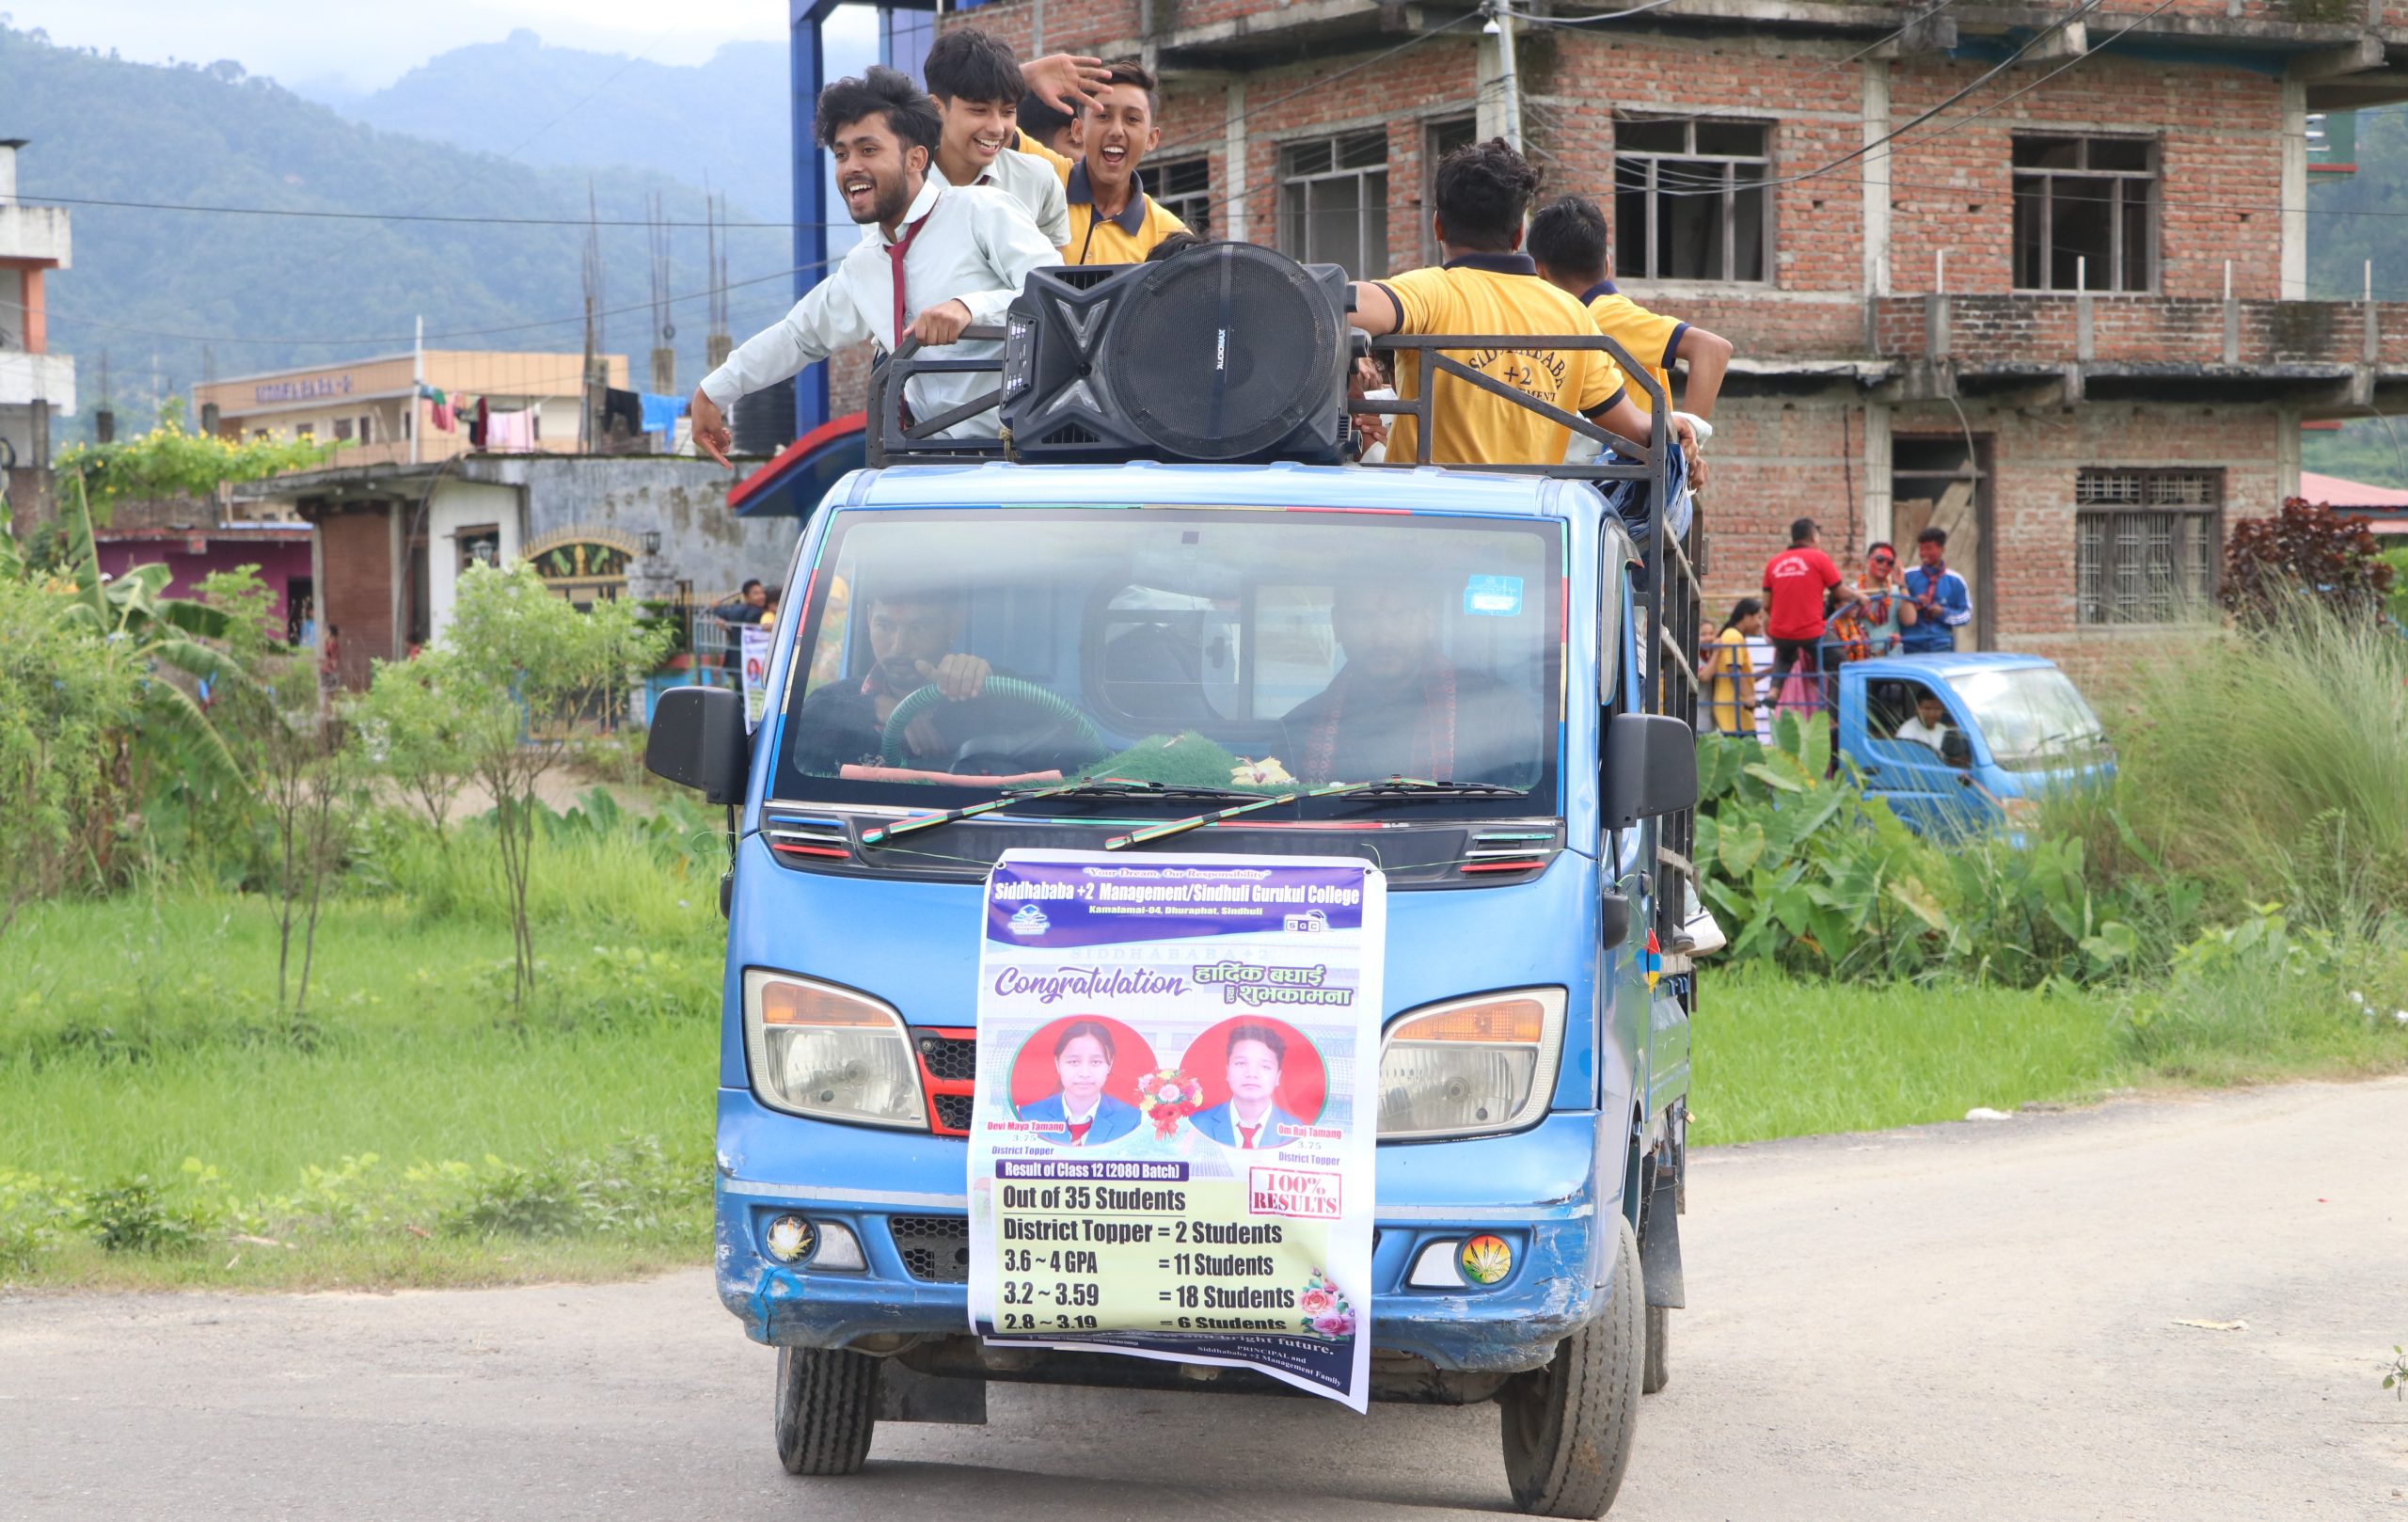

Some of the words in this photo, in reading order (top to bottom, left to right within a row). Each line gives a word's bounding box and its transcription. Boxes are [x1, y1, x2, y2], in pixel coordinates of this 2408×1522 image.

[1216, 328, 1226, 370] AUDIOMAX
[1503, 366, 1531, 386] +2
[1164, 869, 1184, 878] Our
[995, 881, 1074, 900] Siddhababa
[1077, 883, 1095, 900] +2
[1099, 882, 1250, 903] Management/Sindhuli
[1252, 885, 1305, 903] Gurukul
[1307, 885, 1360, 906] College
[1088, 905, 1164, 915] Kamalamai-04,
[1221, 907, 1263, 915] Sindhuli
[1194, 961, 1265, 983] हार्दिक
[994, 966, 1193, 1005] Congratulation
[1238, 985, 1354, 1007] शुभकामना
[988, 1121, 1006, 1131] Devi
[1007, 1122, 1030, 1133] Maya
[1031, 1122, 1065, 1133] Tamang
[1278, 1125, 1292, 1135] Om
[1308, 1127, 1342, 1140] Tamang
[991, 1146, 1023, 1155] District
[1024, 1147, 1054, 1156] Topper
[1278, 1151, 1309, 1164] District
[1310, 1154, 1340, 1166] Topper
[1005, 1162, 1042, 1177] Result
[1043, 1163, 1055, 1177] of
[1056, 1163, 1089, 1178] Class
[1091, 1163, 1104, 1178] 12
[1105, 1163, 1140, 1178] (2080
[1142, 1164, 1180, 1179] Batch)
[1267, 1173, 1326, 1195] 100%
[1003, 1185, 1038, 1209] Out
[1040, 1186, 1061, 1209] of
[1065, 1186, 1091, 1210] 35
[1095, 1187, 1186, 1211] Students
[1253, 1192, 1338, 1214] RESULTS
[1004, 1218, 1078, 1241] District
[1082, 1219, 1153, 1245] Topper
[1158, 1226, 1170, 1237] =
[1175, 1221, 1187, 1244] 2
[1192, 1222, 1283, 1244] Students
[1005, 1249, 1032, 1272] 3.6
[1050, 1250, 1061, 1274] 4
[1064, 1251, 1099, 1274] GPA
[1158, 1258, 1170, 1269] =
[1174, 1252, 1191, 1276] 11
[1195, 1253, 1275, 1276] Students
[1004, 1282, 1034, 1305] 3.2
[1055, 1282, 1100, 1307] 3.59
[1159, 1291, 1172, 1302] =
[1176, 1285, 1199, 1308] 18
[1204, 1285, 1295, 1308] Students
[1005, 1313, 1036, 1329] 2.8
[1056, 1314, 1099, 1329] 3.19
[1178, 1316, 1192, 1328] 6
[1195, 1316, 1287, 1330] Students
[1237, 1345, 1290, 1360] PRINCIPAL
[1291, 1356, 1307, 1364] and
[1277, 1337, 1335, 1356] future.
[1196, 1345, 1248, 1357] Siddhababa
[1261, 1356, 1314, 1376] Management
[1314, 1370, 1342, 1387] Family
